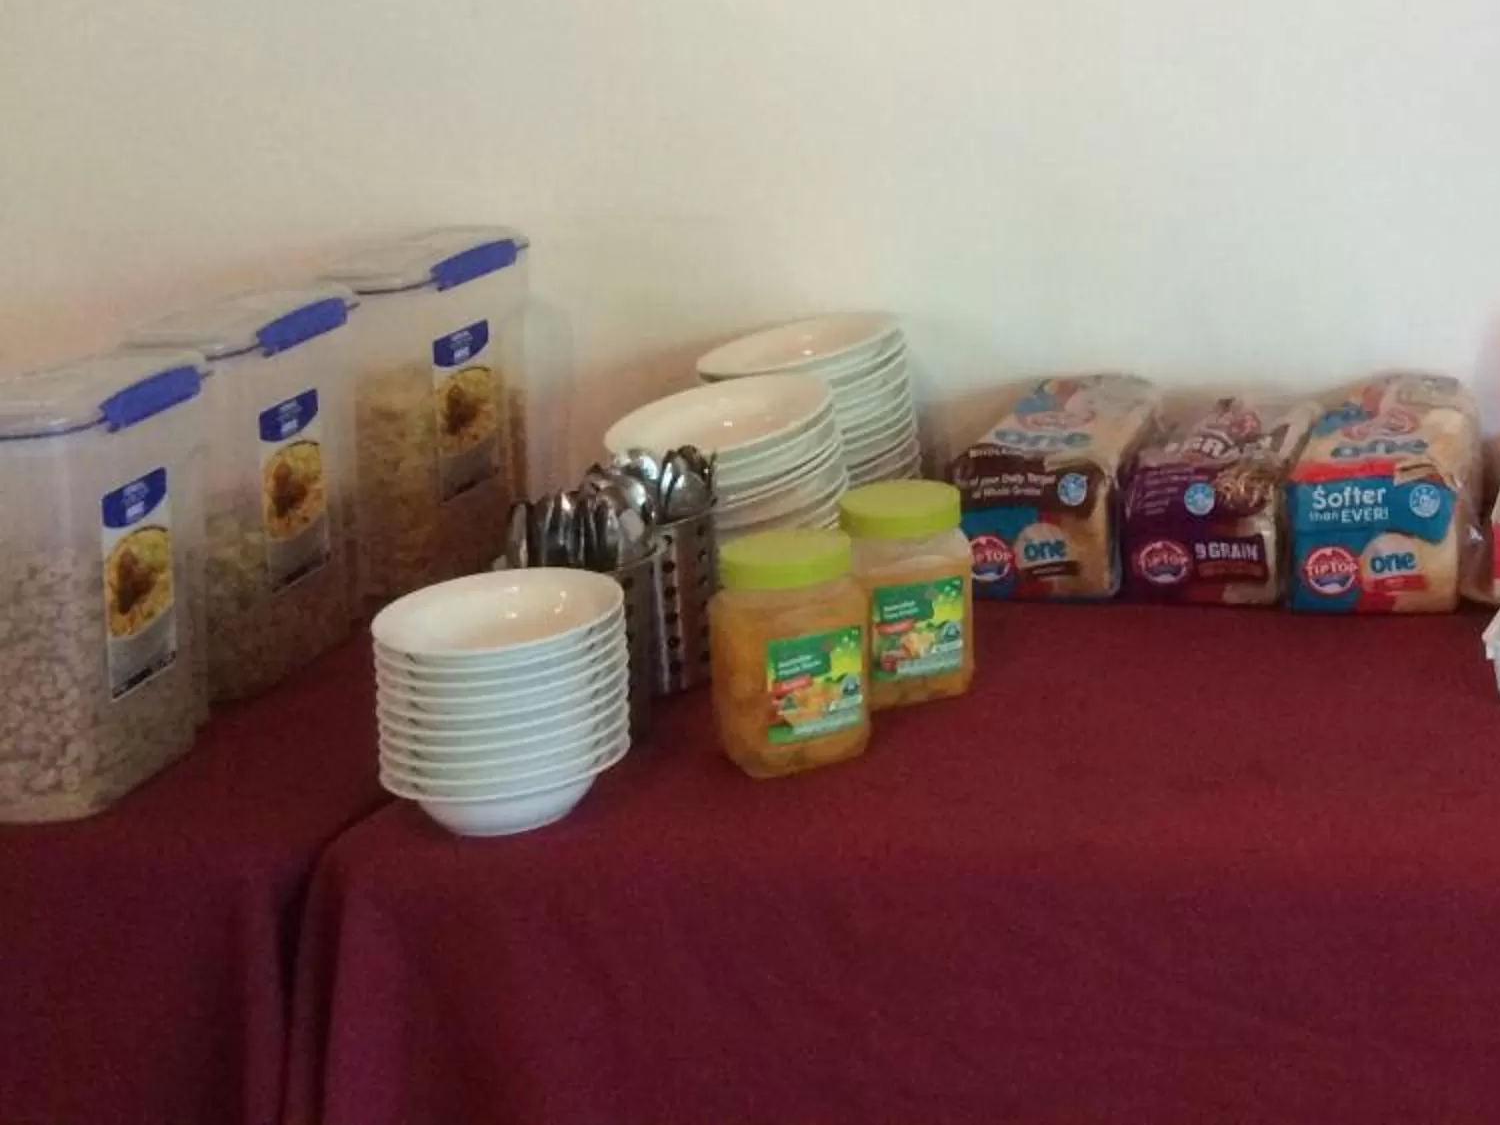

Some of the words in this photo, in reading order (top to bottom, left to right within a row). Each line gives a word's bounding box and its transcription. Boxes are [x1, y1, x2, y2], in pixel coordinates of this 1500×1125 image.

[1311, 485, 1388, 510] Softer
[1341, 506, 1390, 524] EVER!
[1023, 538, 1067, 562] one
[1207, 541, 1259, 561] GRAIN
[1369, 552, 1417, 574] one
